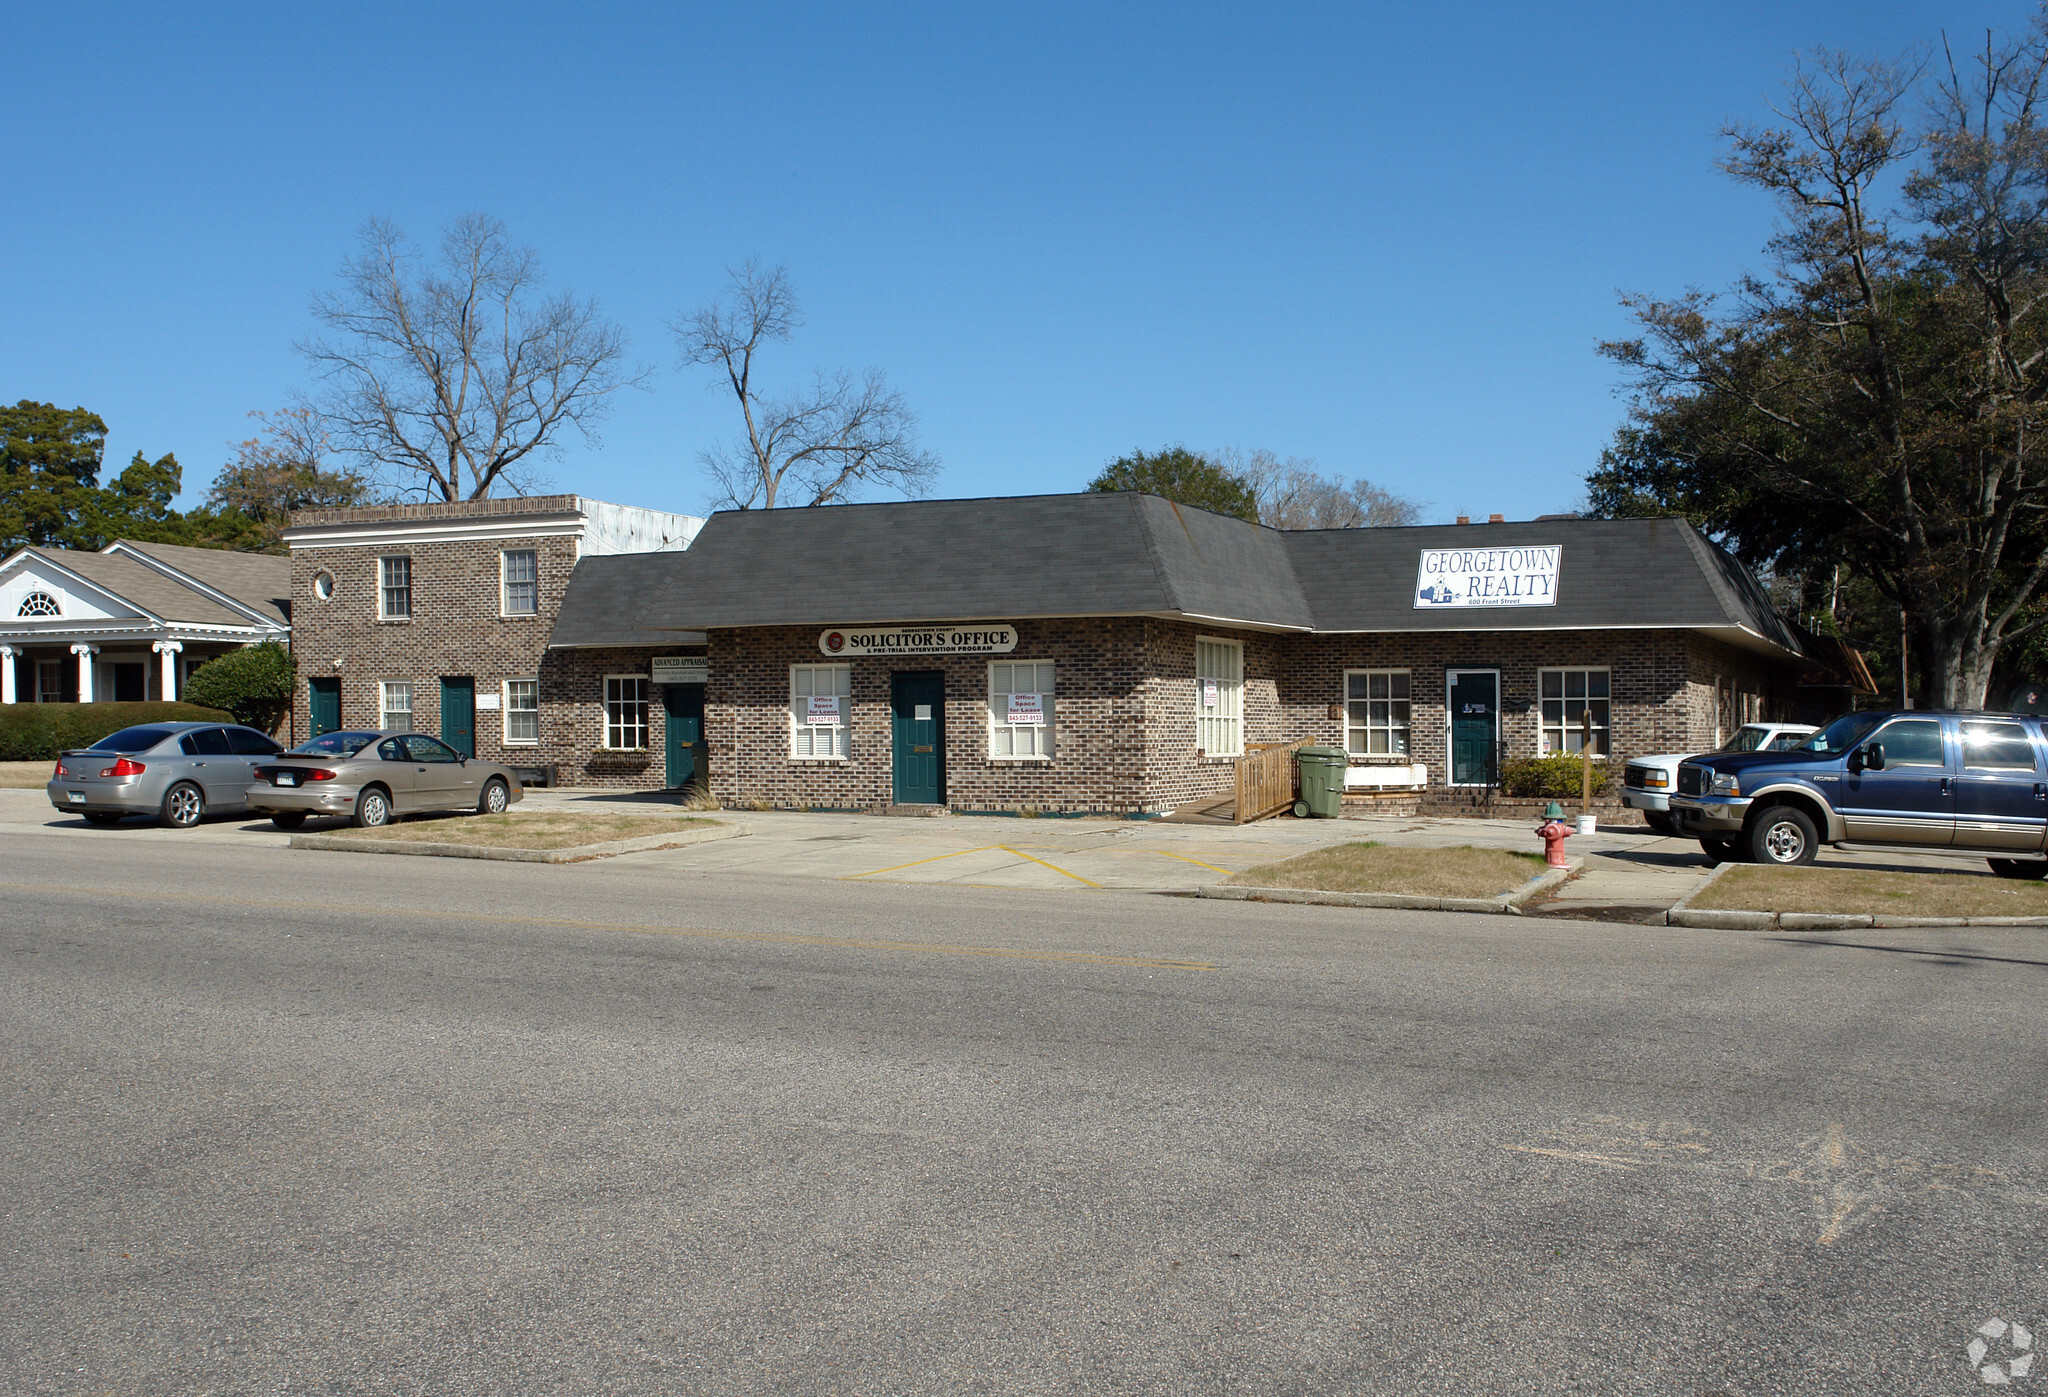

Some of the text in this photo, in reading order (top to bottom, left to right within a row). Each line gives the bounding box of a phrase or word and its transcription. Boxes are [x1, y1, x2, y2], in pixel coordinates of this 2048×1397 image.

[1426, 549, 1555, 573] GEORGETOWN
[1467, 574, 1554, 597] REALTY
[850, 631, 1010, 647] SOLICITOR'S OFFICE
[654, 658, 680, 666] ADVANCED
